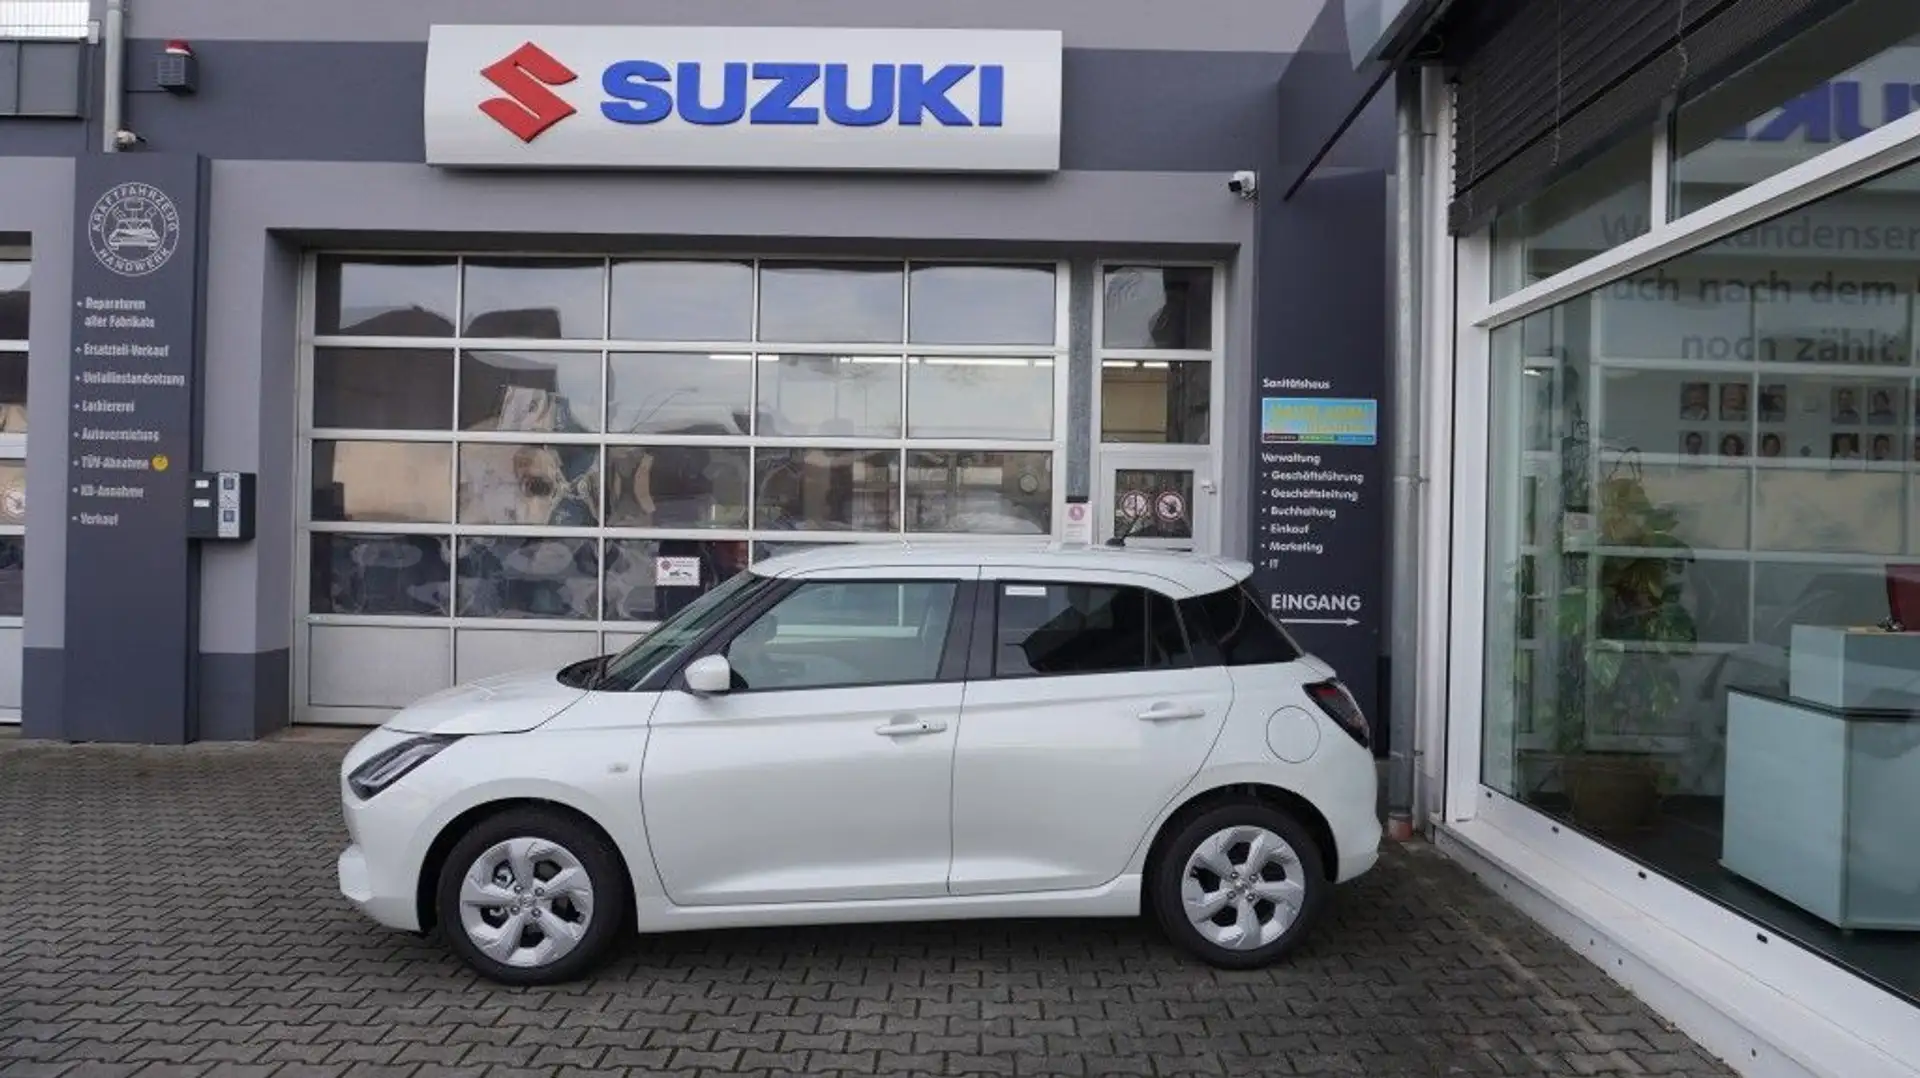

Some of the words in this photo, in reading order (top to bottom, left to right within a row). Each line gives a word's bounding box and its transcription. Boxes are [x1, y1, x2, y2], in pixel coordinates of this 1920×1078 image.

[600, 60, 1004, 127] SUZUKI
[91, 185, 179, 232] KRAFTFAHRZEUG
[99, 247, 171, 272] HANDWERK
[1698, 269, 1791, 302] nach
[1809, 271, 1897, 305] dem
[86, 296, 146, 311] Reparaturen
[84, 315, 107, 328] aller
[109, 315, 155, 329] Fabrikate
[83, 343, 169, 357] Ersatzteil-Verkauf
[1681, 328, 1777, 361] noch
[83, 371, 185, 387] Unfallinstandsetzung
[1262, 378, 1331, 390] Sanitätshaus
[82, 400, 135, 413] Lackiererei
[81, 428, 160, 442] Autovermietung
[81, 454, 149, 470] TÜV-Abnahme
[1261, 452, 1321, 466] Verwaltung
[1271, 470, 1364, 485] Geschäftsführung
[1271, 487, 1358, 502] Geschäftsleitung
[80, 512, 119, 526] Verkauf
[1271, 506, 1337, 519] Buchhaltung
[1270, 523, 1310, 534] Einkauf
[1269, 541, 1323, 555] Marketing
[1269, 558, 1279, 569] IT
[1271, 594, 1362, 611] EINGANG
